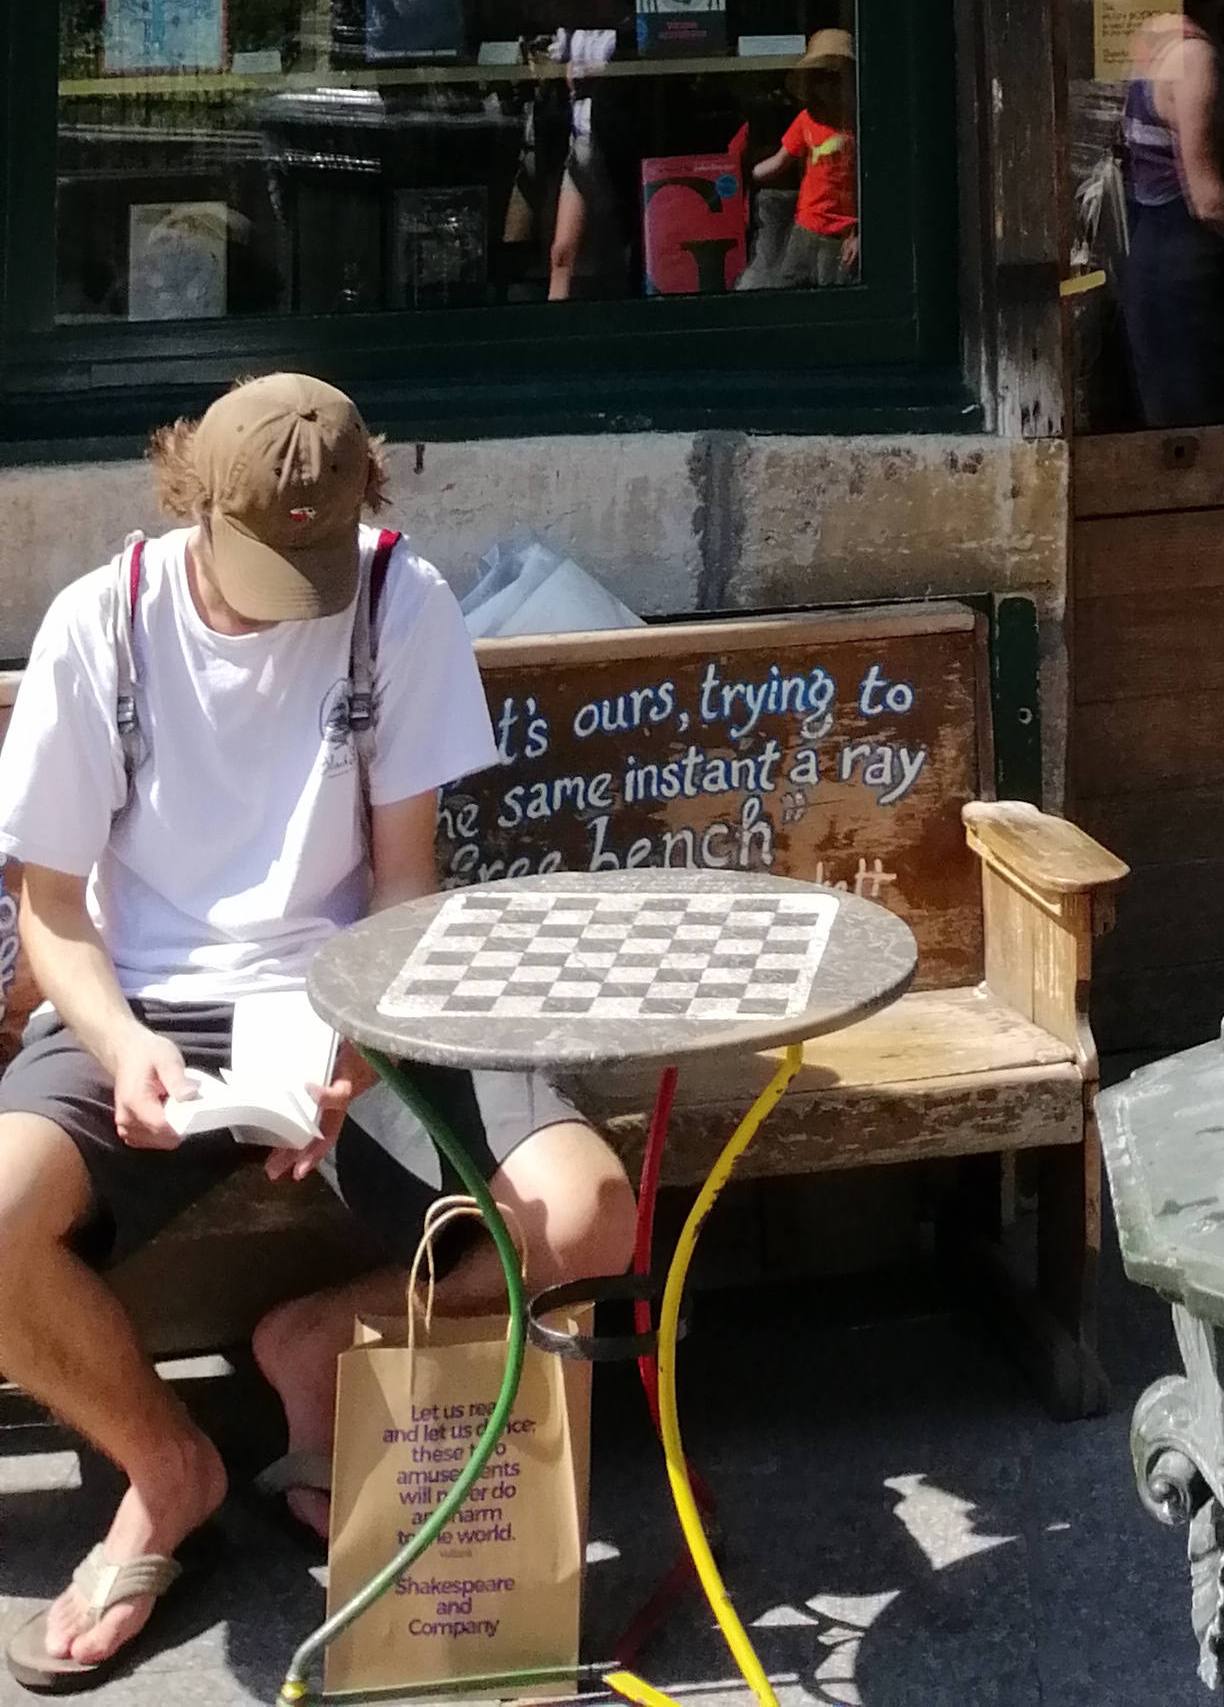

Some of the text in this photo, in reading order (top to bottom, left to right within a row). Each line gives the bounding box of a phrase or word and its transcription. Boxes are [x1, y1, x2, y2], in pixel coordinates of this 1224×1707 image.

[572, 680, 689, 739] ours,
[700, 663, 837, 741] trying
[858, 663, 915, 717] to
[497, 772, 613, 829] same
[624, 741, 783, 804] instant
[841, 742, 926, 806] ray
[411, 1401, 511, 1422] Let us rea
[382, 1426, 419, 1443] and
[424, 1423, 446, 1442] let
[451, 1425, 472, 1440] us
[412, 1442, 507, 1463] these to
[396, 1461, 521, 1485] amuseents
[399, 1481, 517, 1505] will ner do
[457, 1522, 516, 1543] world.
[395, 1576, 516, 1598] Shakespeare
[436, 1597, 472, 1615] and
[408, 1618, 500, 1638] Company
